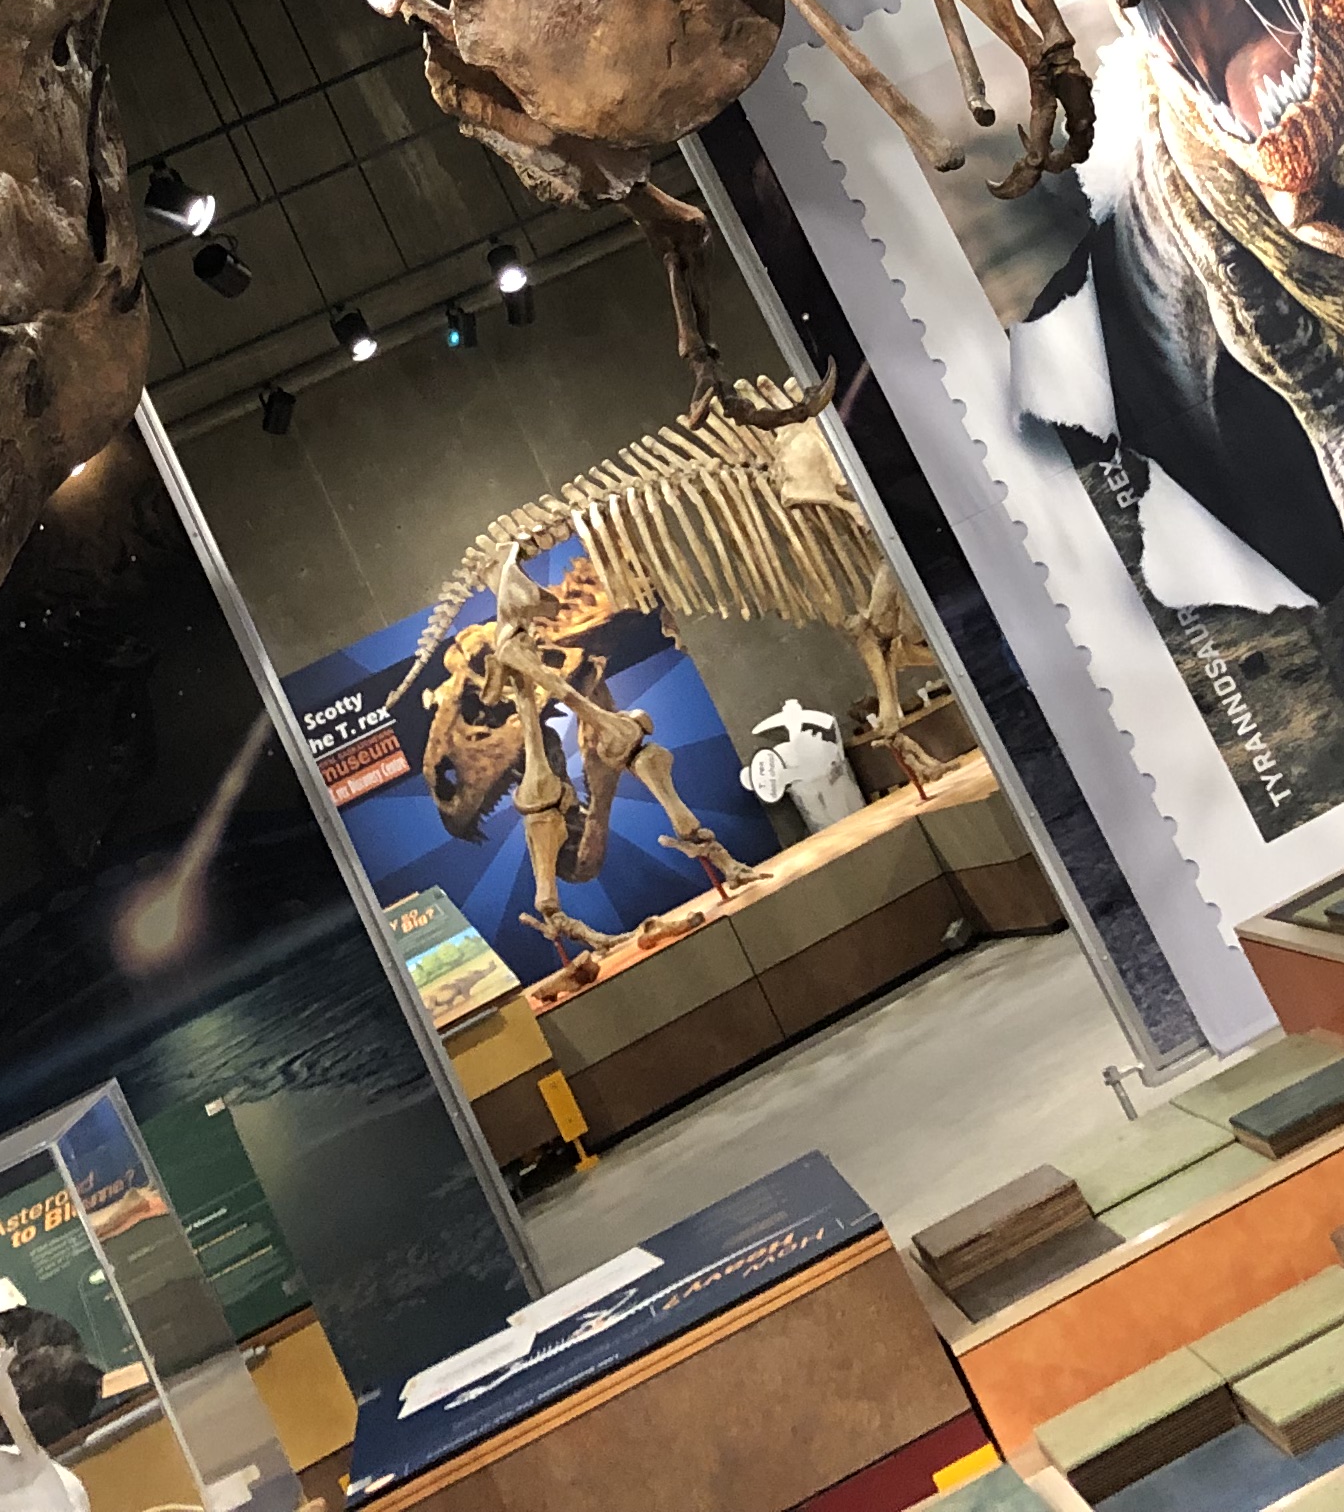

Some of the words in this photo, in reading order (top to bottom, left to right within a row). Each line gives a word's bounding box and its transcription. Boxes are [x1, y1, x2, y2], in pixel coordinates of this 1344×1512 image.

[1098, 461, 1141, 509] REX
[303, 691, 363, 731] Scotty
[307, 733, 335, 754] he
[334, 721, 357, 740] T.
[357, 705, 391, 730] rex
[10, 1224, 38, 1249] to
